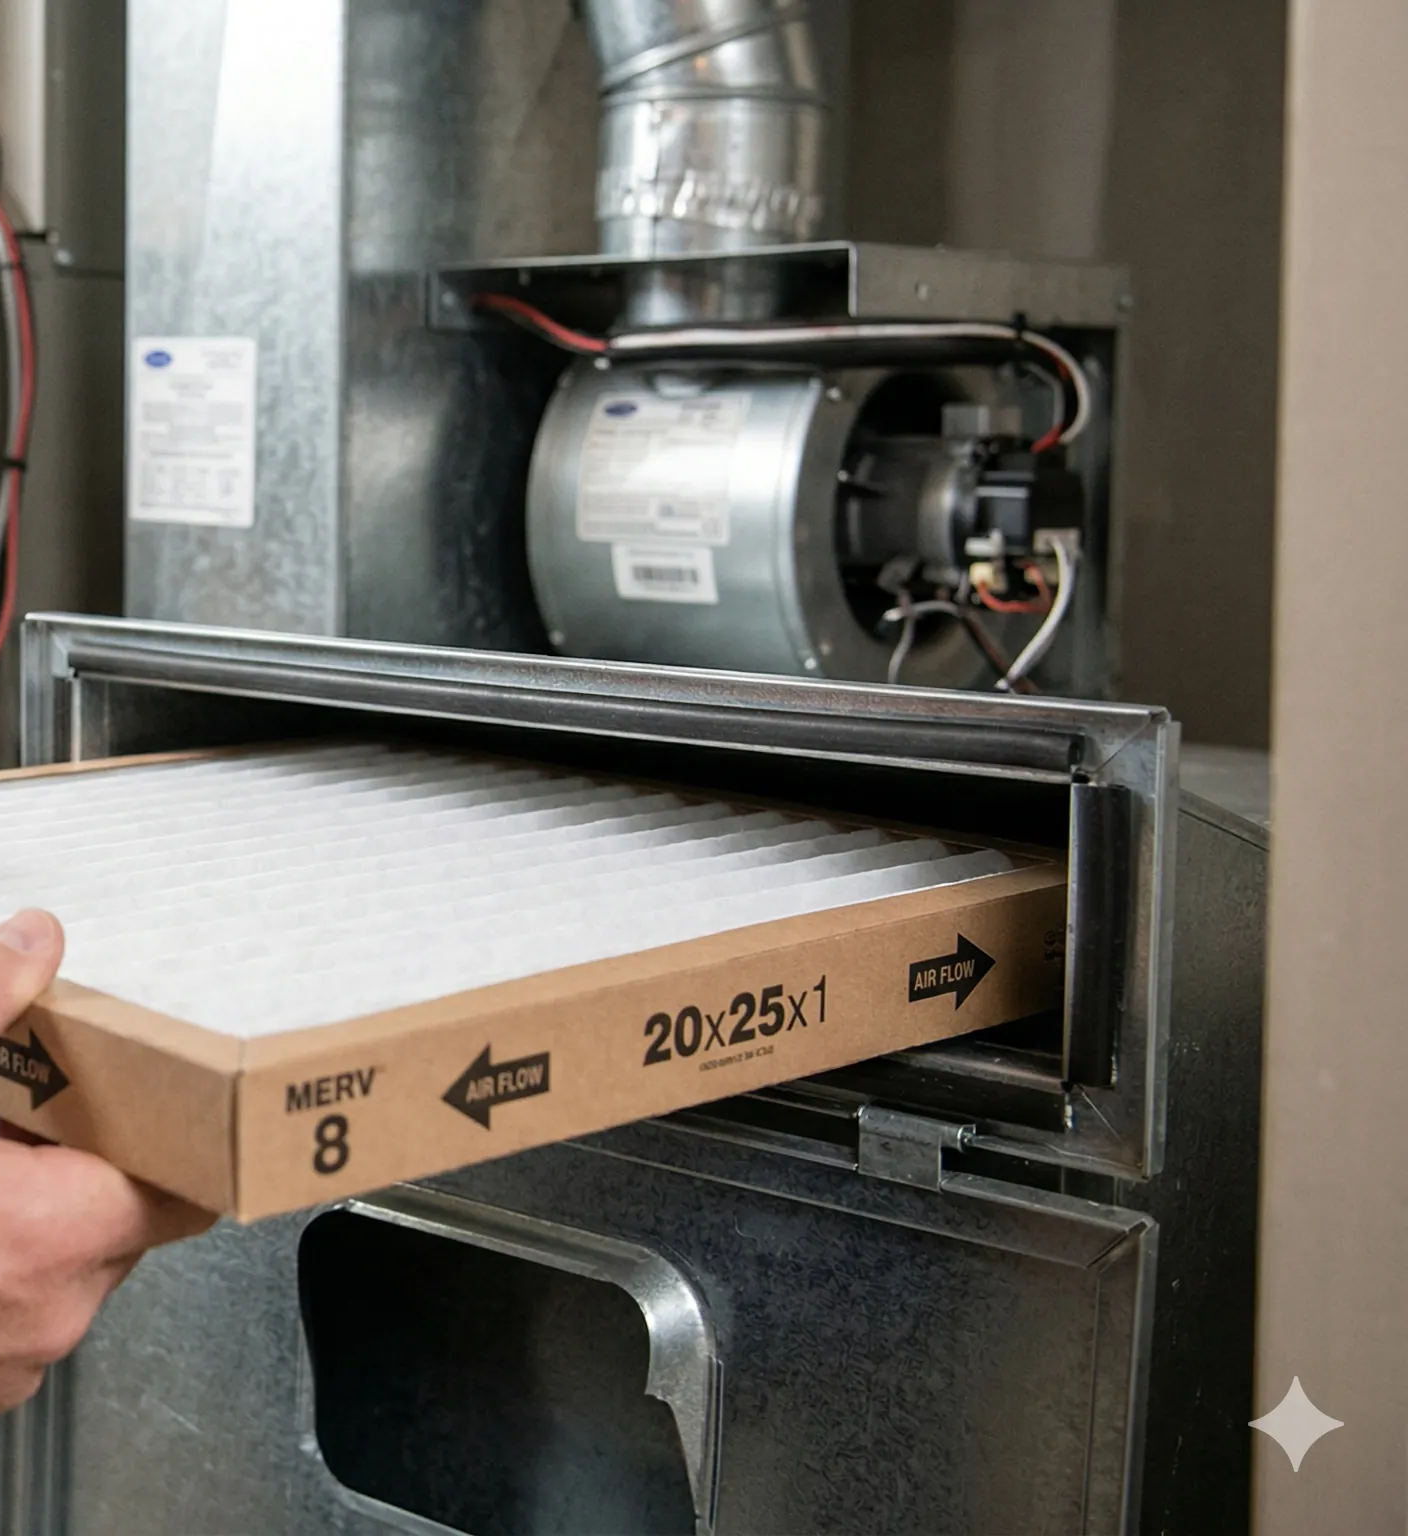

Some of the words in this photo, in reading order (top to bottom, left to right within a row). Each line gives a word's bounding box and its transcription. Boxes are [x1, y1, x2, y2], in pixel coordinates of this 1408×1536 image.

[914, 968, 937, 992] AIR
[939, 959, 976, 985] FLOW
[643, 974, 827, 1067] 20x25x1
[12, 1052, 51, 1085] FLOW
[285, 1065, 377, 1114] MERV
[465, 1075, 495, 1104] AIR
[497, 1062, 545, 1096] FLOW
[312, 1113, 350, 1176] 8
